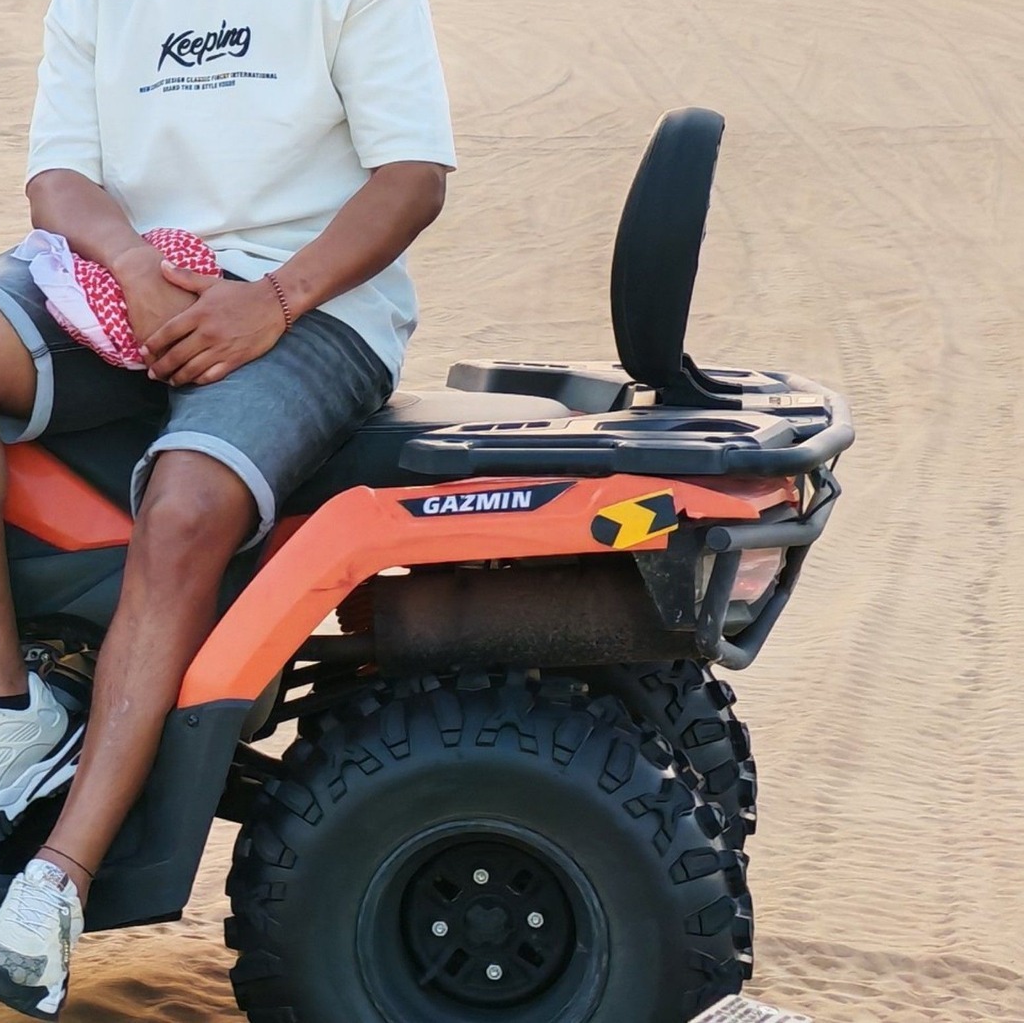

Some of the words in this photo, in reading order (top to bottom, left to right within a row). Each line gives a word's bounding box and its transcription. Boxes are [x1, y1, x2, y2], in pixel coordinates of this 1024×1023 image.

[157, 19, 251, 71] Keeping
[230, 71, 277, 79] INTERNATIONAL
[423, 490, 533, 514] GAZMIN
